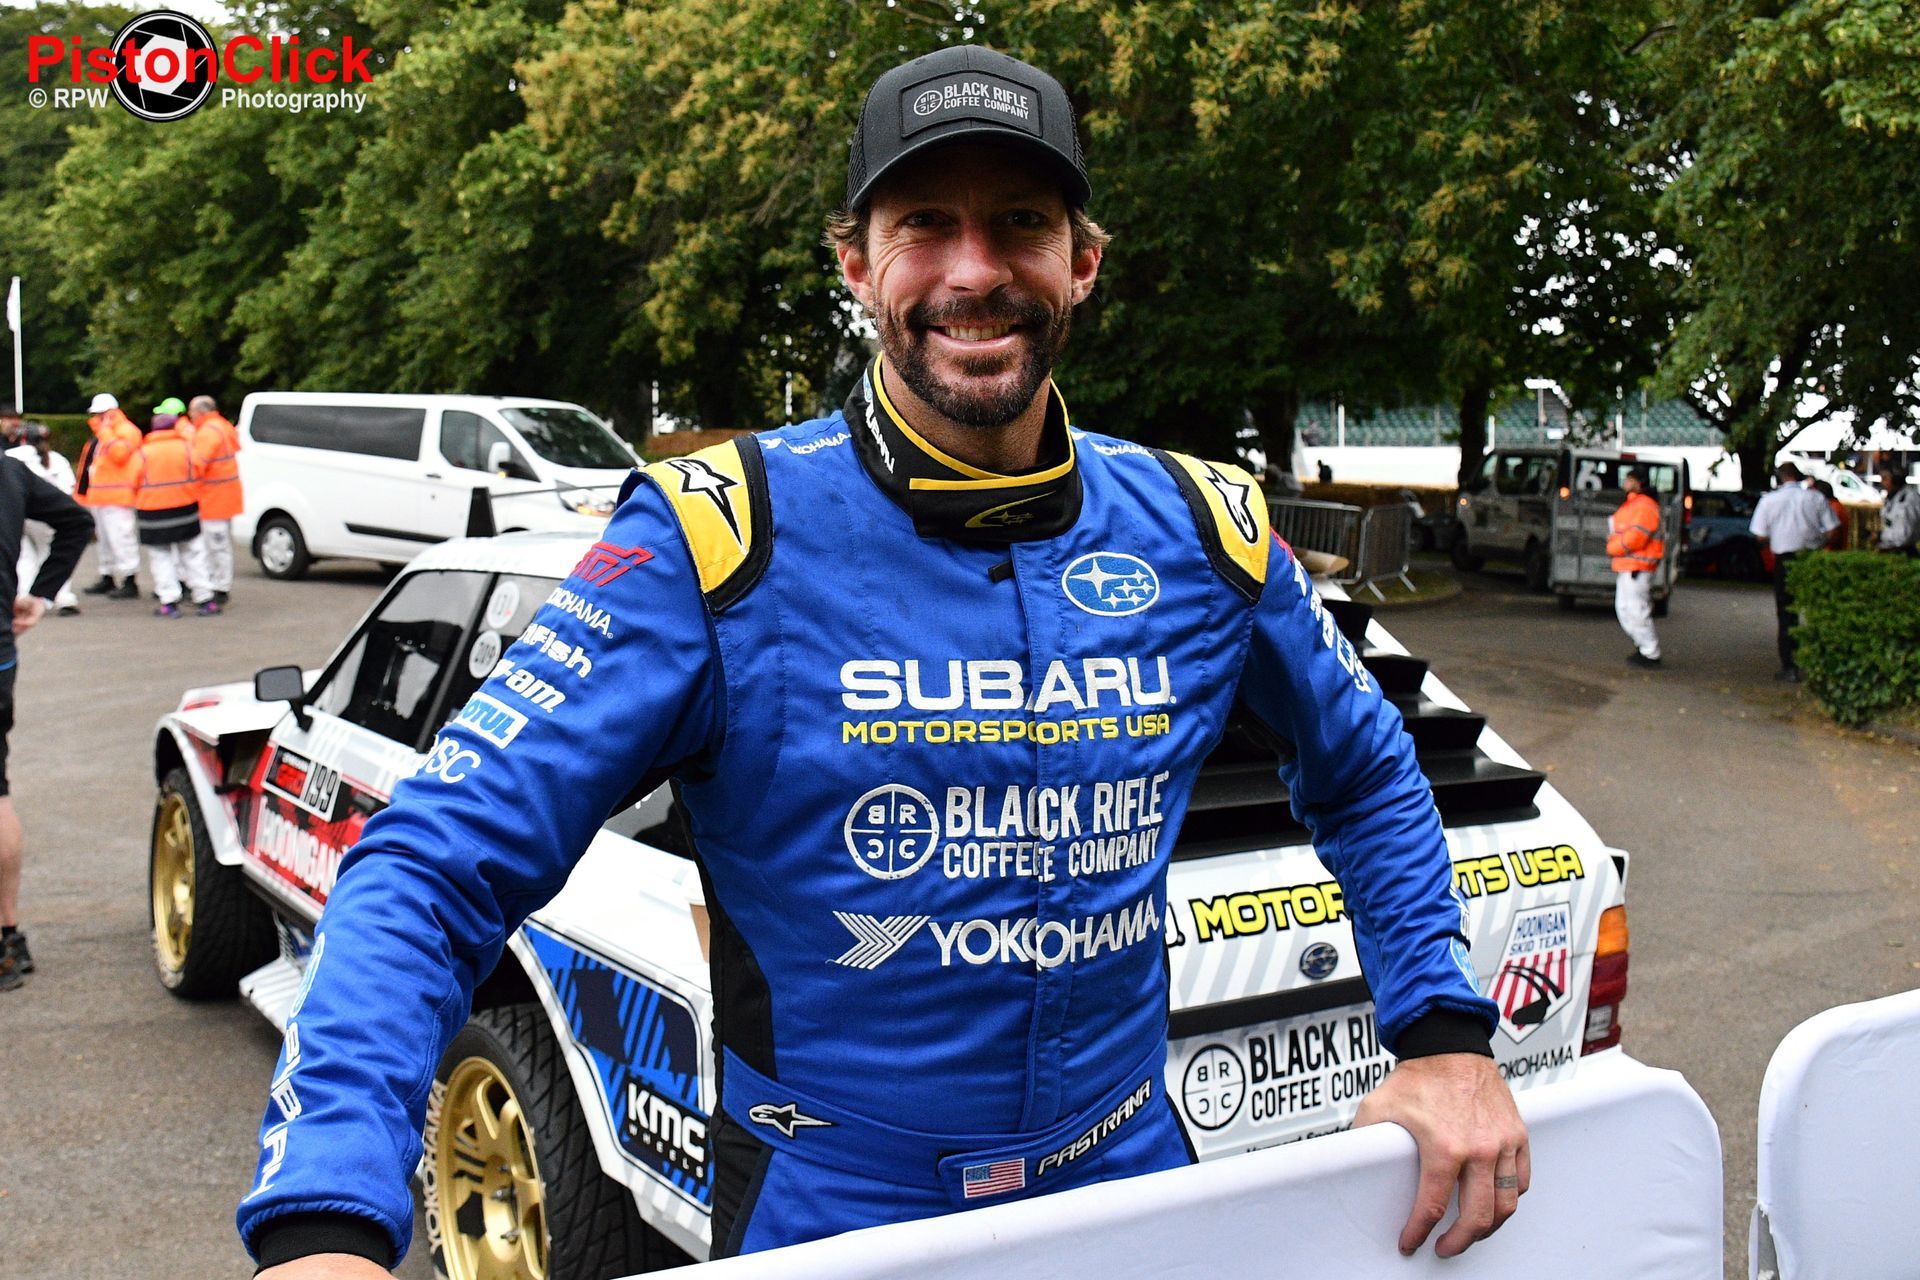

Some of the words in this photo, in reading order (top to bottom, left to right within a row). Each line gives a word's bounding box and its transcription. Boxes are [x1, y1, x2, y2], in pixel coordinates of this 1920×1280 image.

[944, 82, 990, 99] BLACK
[993, 87, 1028, 110] RIFLE
[944, 97, 980, 109] COFFEE
[984, 99, 1028, 119] COMPANY
[839, 656, 1171, 712] SUBARU
[461, 699, 515, 740] OTUL
[842, 716, 1119, 744] MOTORSPORTS
[1126, 714, 1170, 738] USA
[946, 784, 1081, 841] BLACK
[1093, 776, 1164, 835] RIFLE
[943, 842, 1055, 883] COFFEE
[1069, 826, 1160, 875] COMPANY
[1512, 845, 1585, 887] USA
[928, 894, 1158, 970] YOKOHAMA
[1539, 934, 1567, 949] TEAM
[1249, 1021, 1340, 1084] BLACK
[1500, 1045, 1574, 1080] OKOHAMA
[628, 1083, 705, 1162] KMC
[1252, 1076, 1321, 1121] COFFEE
[628, 1122, 704, 1178] WHEELS
[1038, 1080, 1151, 1175] PASTRANA
